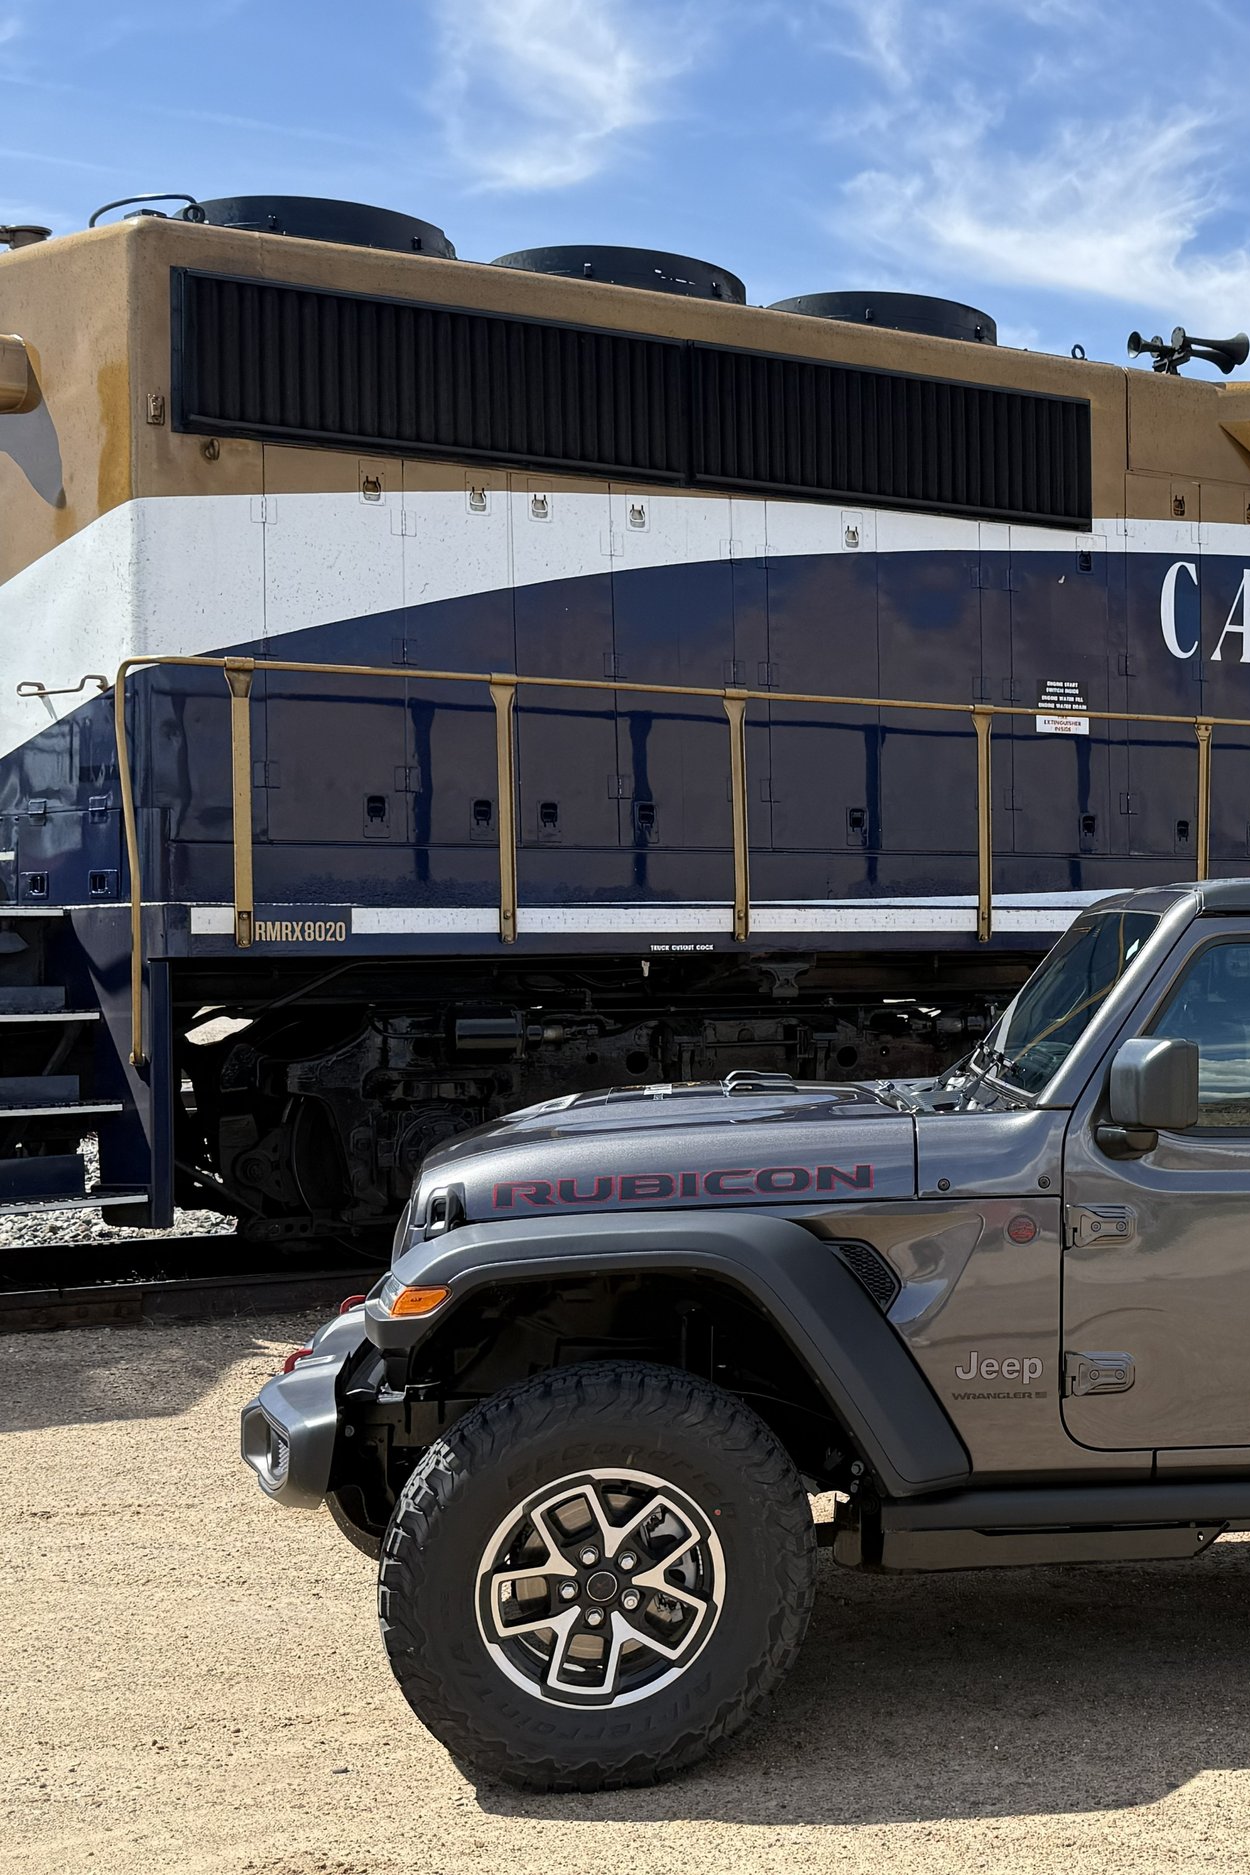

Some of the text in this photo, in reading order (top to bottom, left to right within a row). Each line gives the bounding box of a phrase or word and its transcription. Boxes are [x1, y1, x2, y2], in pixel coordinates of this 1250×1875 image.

[492, 1164, 875, 1209] RUBICON
[955, 1350, 1044, 1385] Jeep
[951, 1391, 1033, 1401] WRANGLER
[507, 1443, 737, 1519] BFGoodrich
